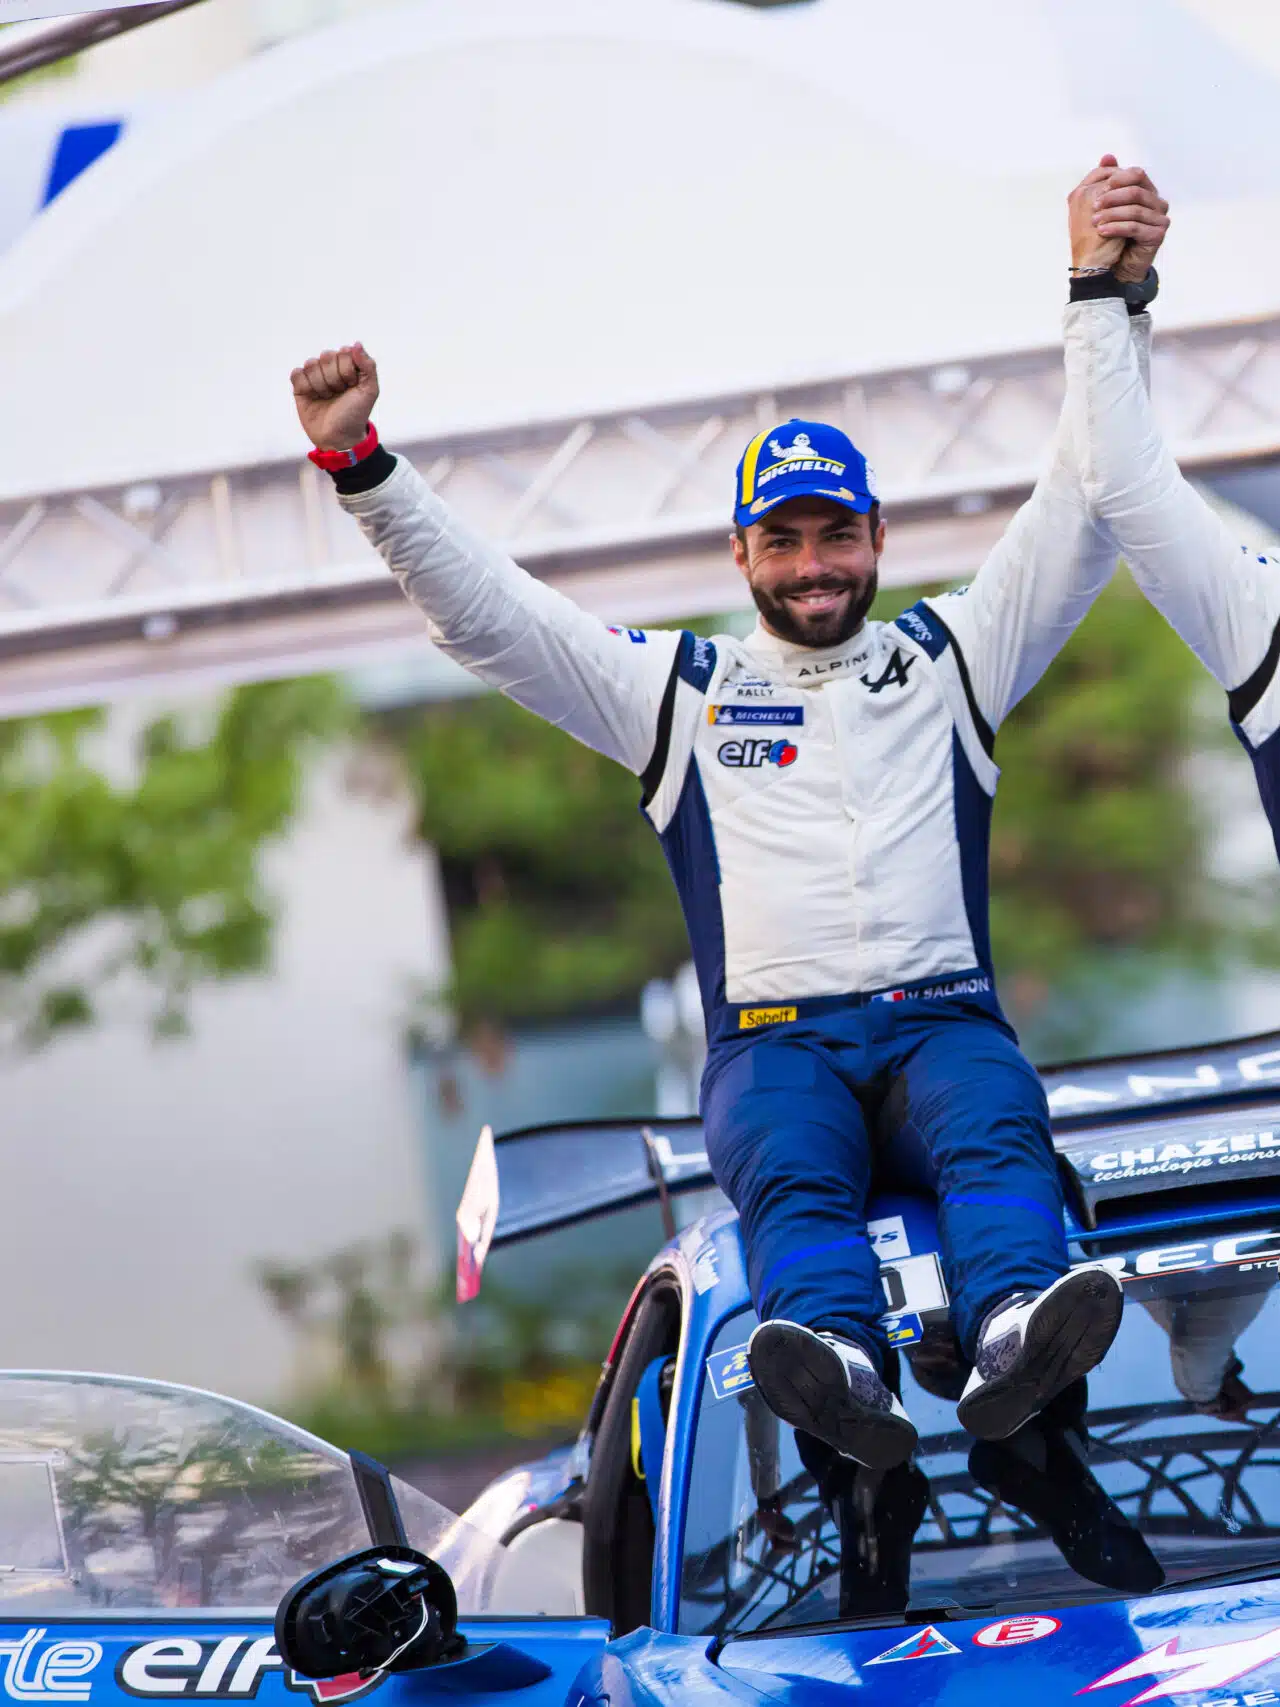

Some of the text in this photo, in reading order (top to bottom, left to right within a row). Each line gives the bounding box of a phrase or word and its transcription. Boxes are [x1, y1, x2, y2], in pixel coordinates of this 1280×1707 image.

[757, 460, 845, 488] MICHELIN
[798, 652, 869, 677] ALPINE
[736, 688, 775, 697] RALLY
[735, 711, 797, 722] MICHELIN
[717, 738, 772, 768] elf
[923, 977, 990, 1000] SALMON
[746, 1008, 793, 1027] Sabelt
[1093, 1157, 1214, 1183] technologie
[1238, 1259, 1279, 1272] STO
